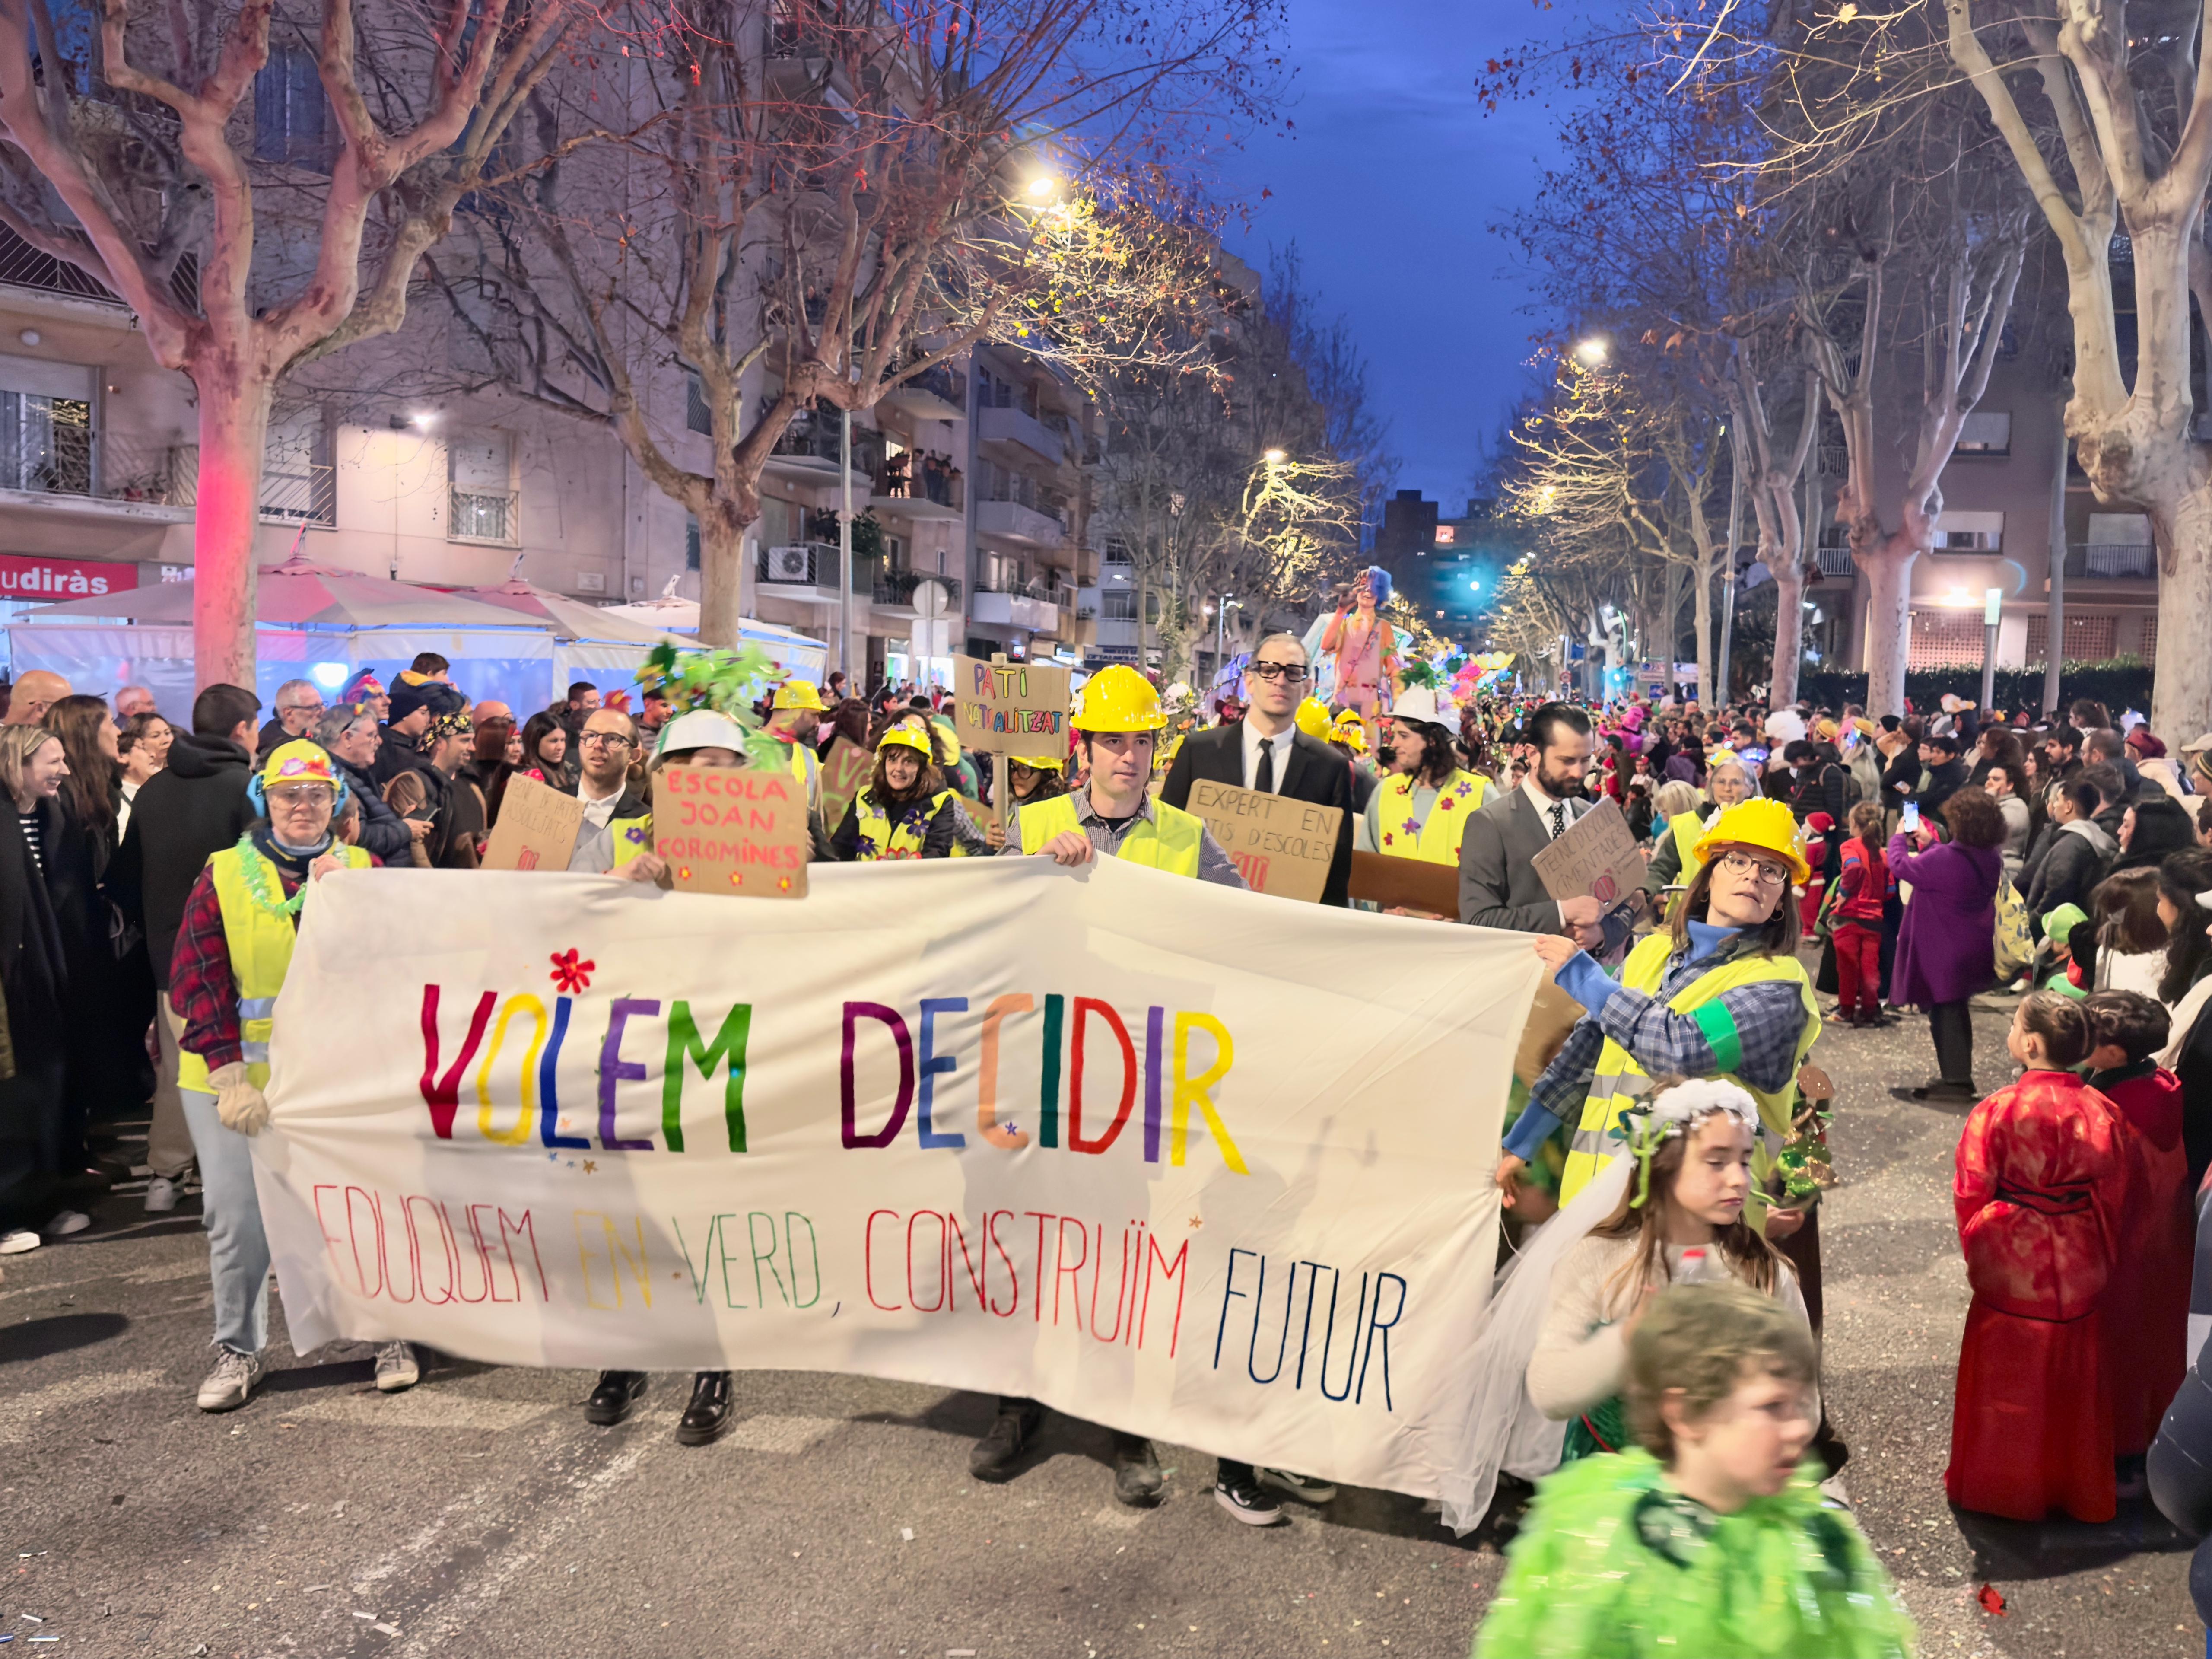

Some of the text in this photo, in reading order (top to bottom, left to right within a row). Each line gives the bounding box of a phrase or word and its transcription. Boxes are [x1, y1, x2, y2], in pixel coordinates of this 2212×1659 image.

[1, 567, 108, 595] udiràs
[667, 769, 788, 802] ESCOLA
[680, 800, 775, 834] JOAN
[1197, 785, 1334, 835] EXPERT EN
[1248, 828, 1332, 863] D'ESCOLES
[420, 983, 1251, 1176] VOLEM DECIDIR
[313, 1185, 1407, 1412] EDUQUEM EN VERD, CONSTRUÏM FUTUR
